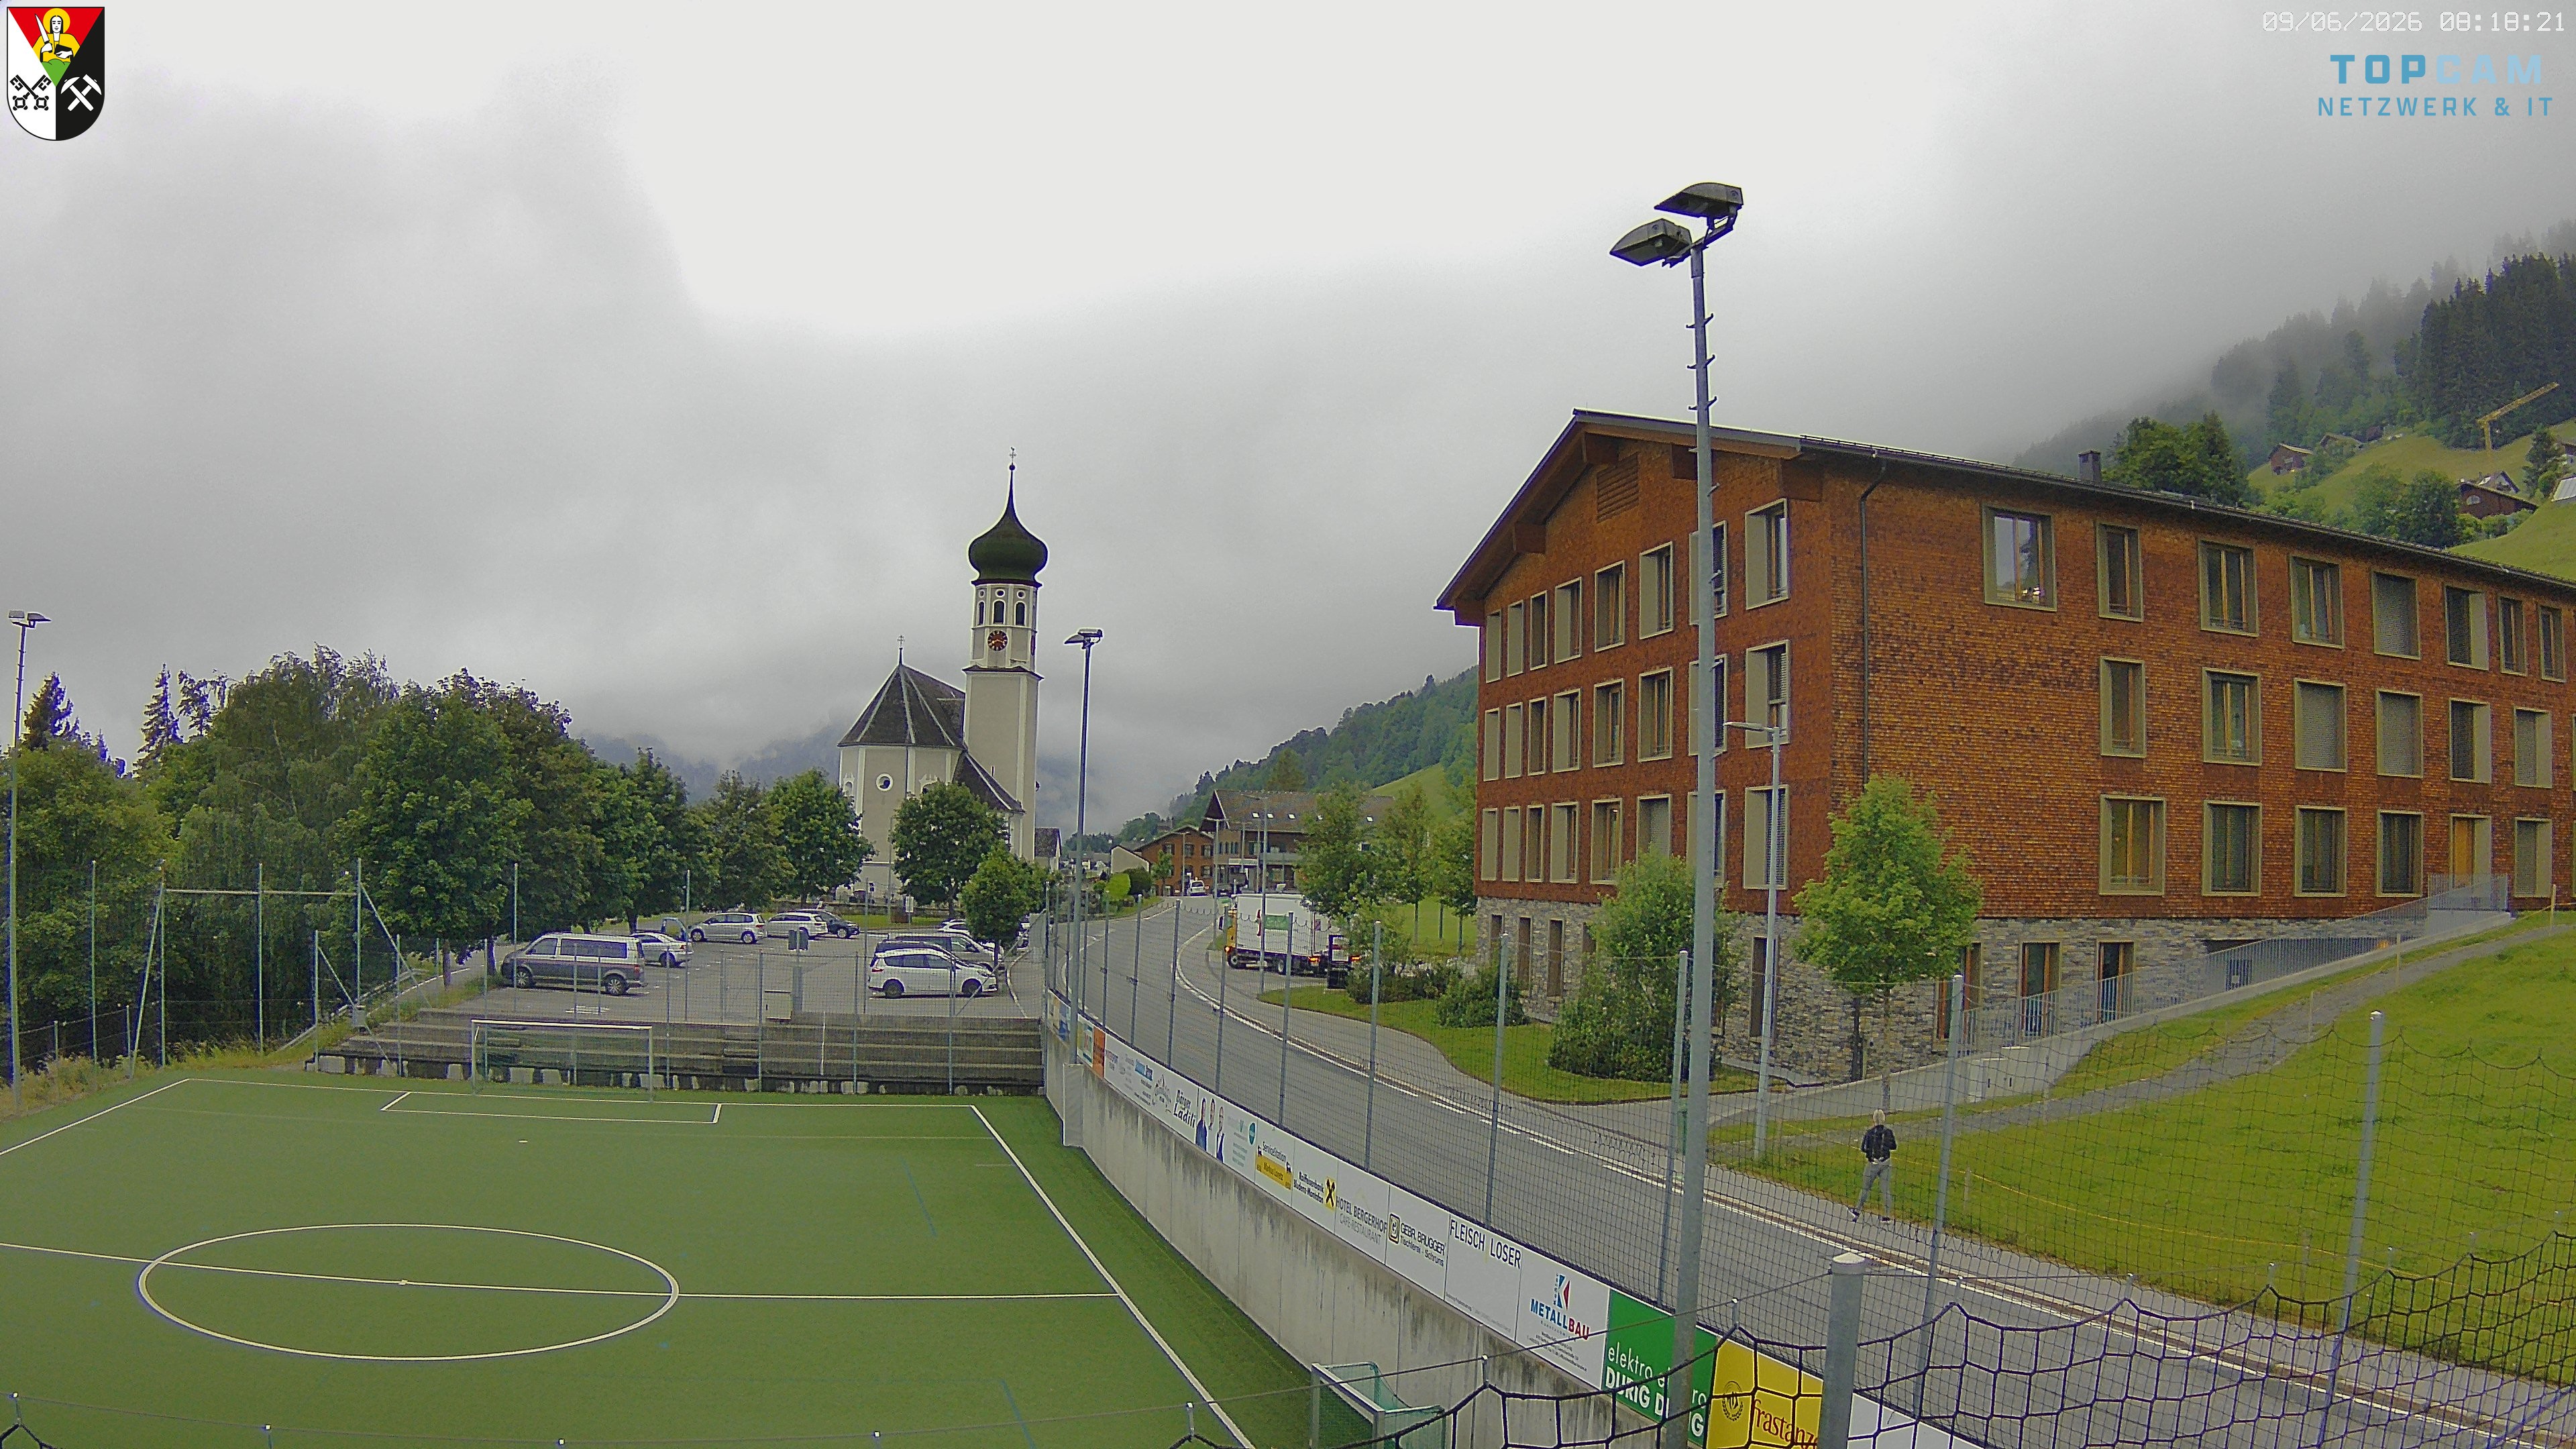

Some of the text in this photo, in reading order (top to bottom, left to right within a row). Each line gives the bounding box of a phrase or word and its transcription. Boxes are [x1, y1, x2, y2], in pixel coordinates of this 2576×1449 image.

[1336, 1196, 1388, 1233] HOTEL BERGERHOF
[1450, 1219, 1521, 1269] FLEISCH LOSER
[1530, 1298, 1591, 1340] METALLBAU
[1608, 1342, 1653, 1379] elektro
